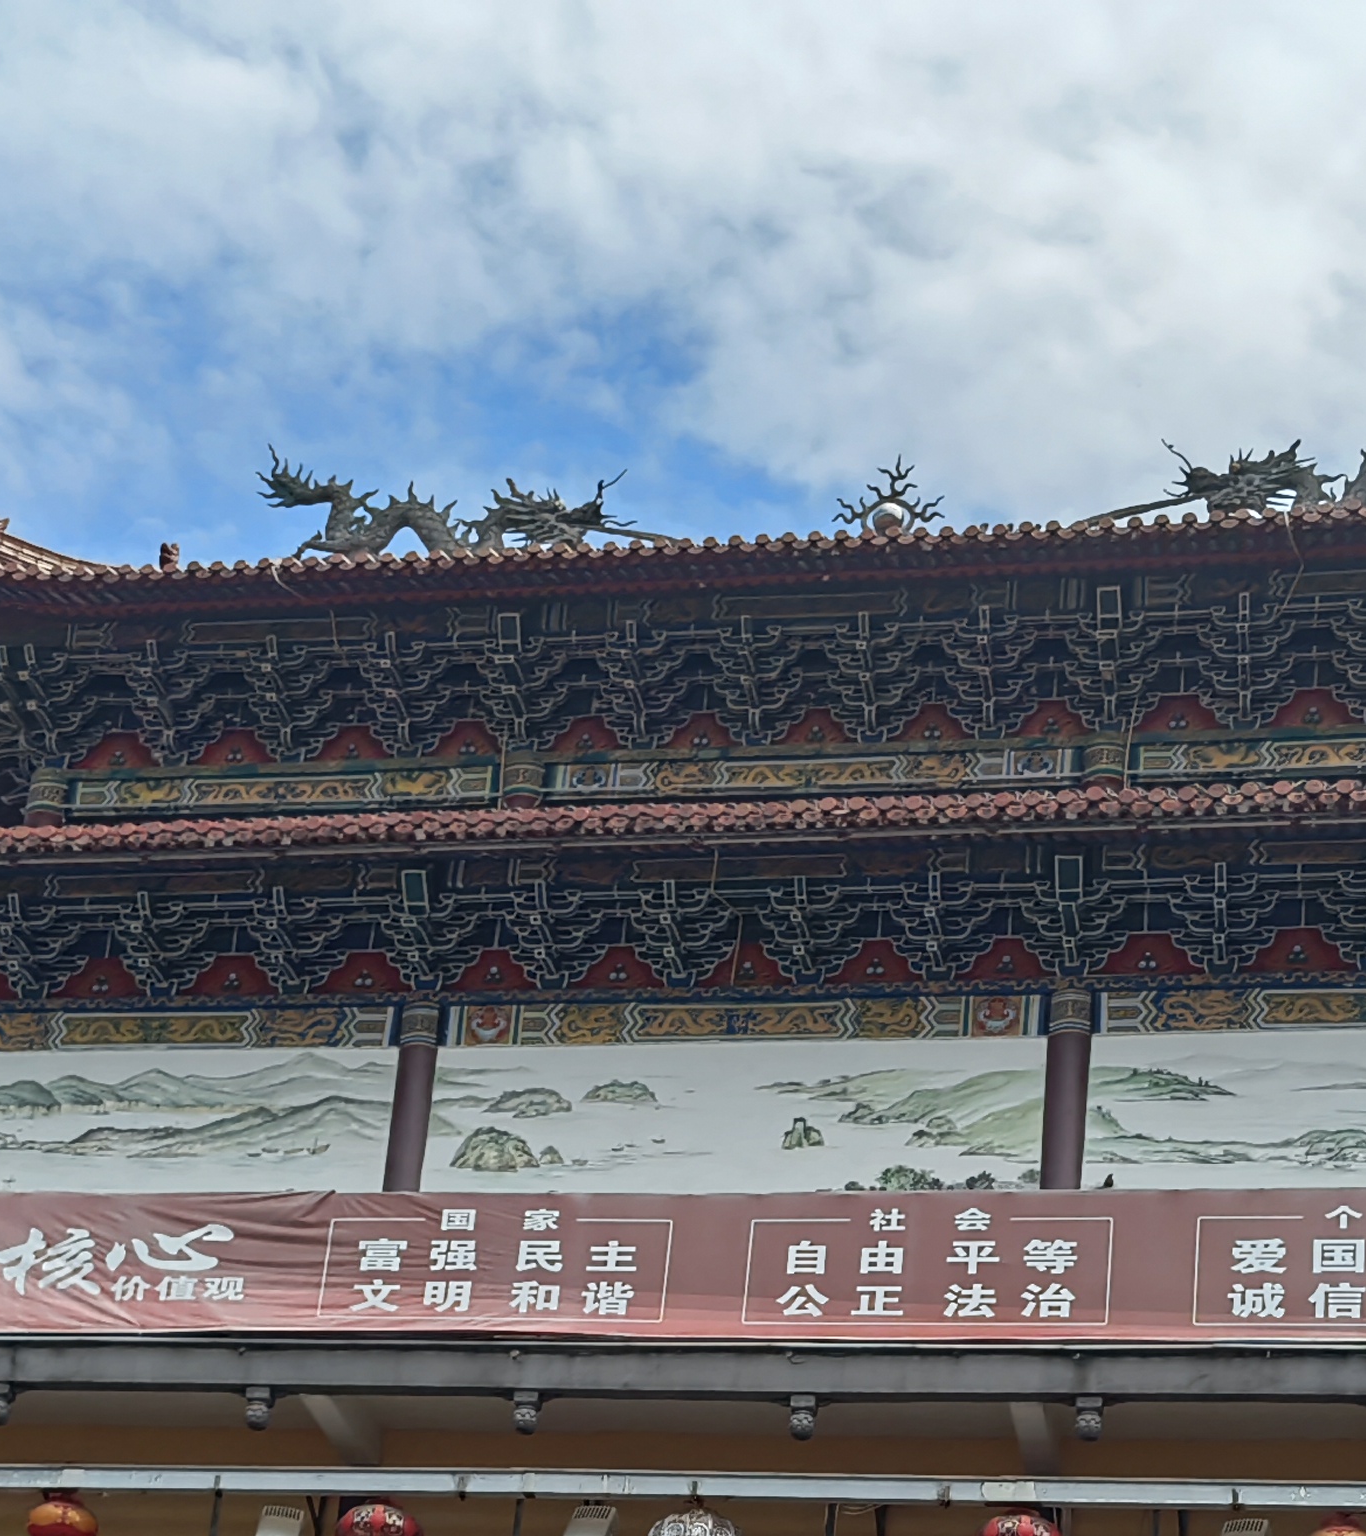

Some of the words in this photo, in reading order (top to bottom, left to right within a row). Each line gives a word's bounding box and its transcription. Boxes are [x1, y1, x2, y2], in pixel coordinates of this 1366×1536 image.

[440, 1208, 561, 1232] 国家
[869, 1208, 992, 1232] 社会
[358, 1238, 638, 1272] 富强民主
[786, 1238, 1079, 1275] 自由平等
[109, 1275, 246, 1302] 价值观
[349, 1279, 636, 1316] 文明和谐
[775, 1283, 1077, 1319] 公正法治
